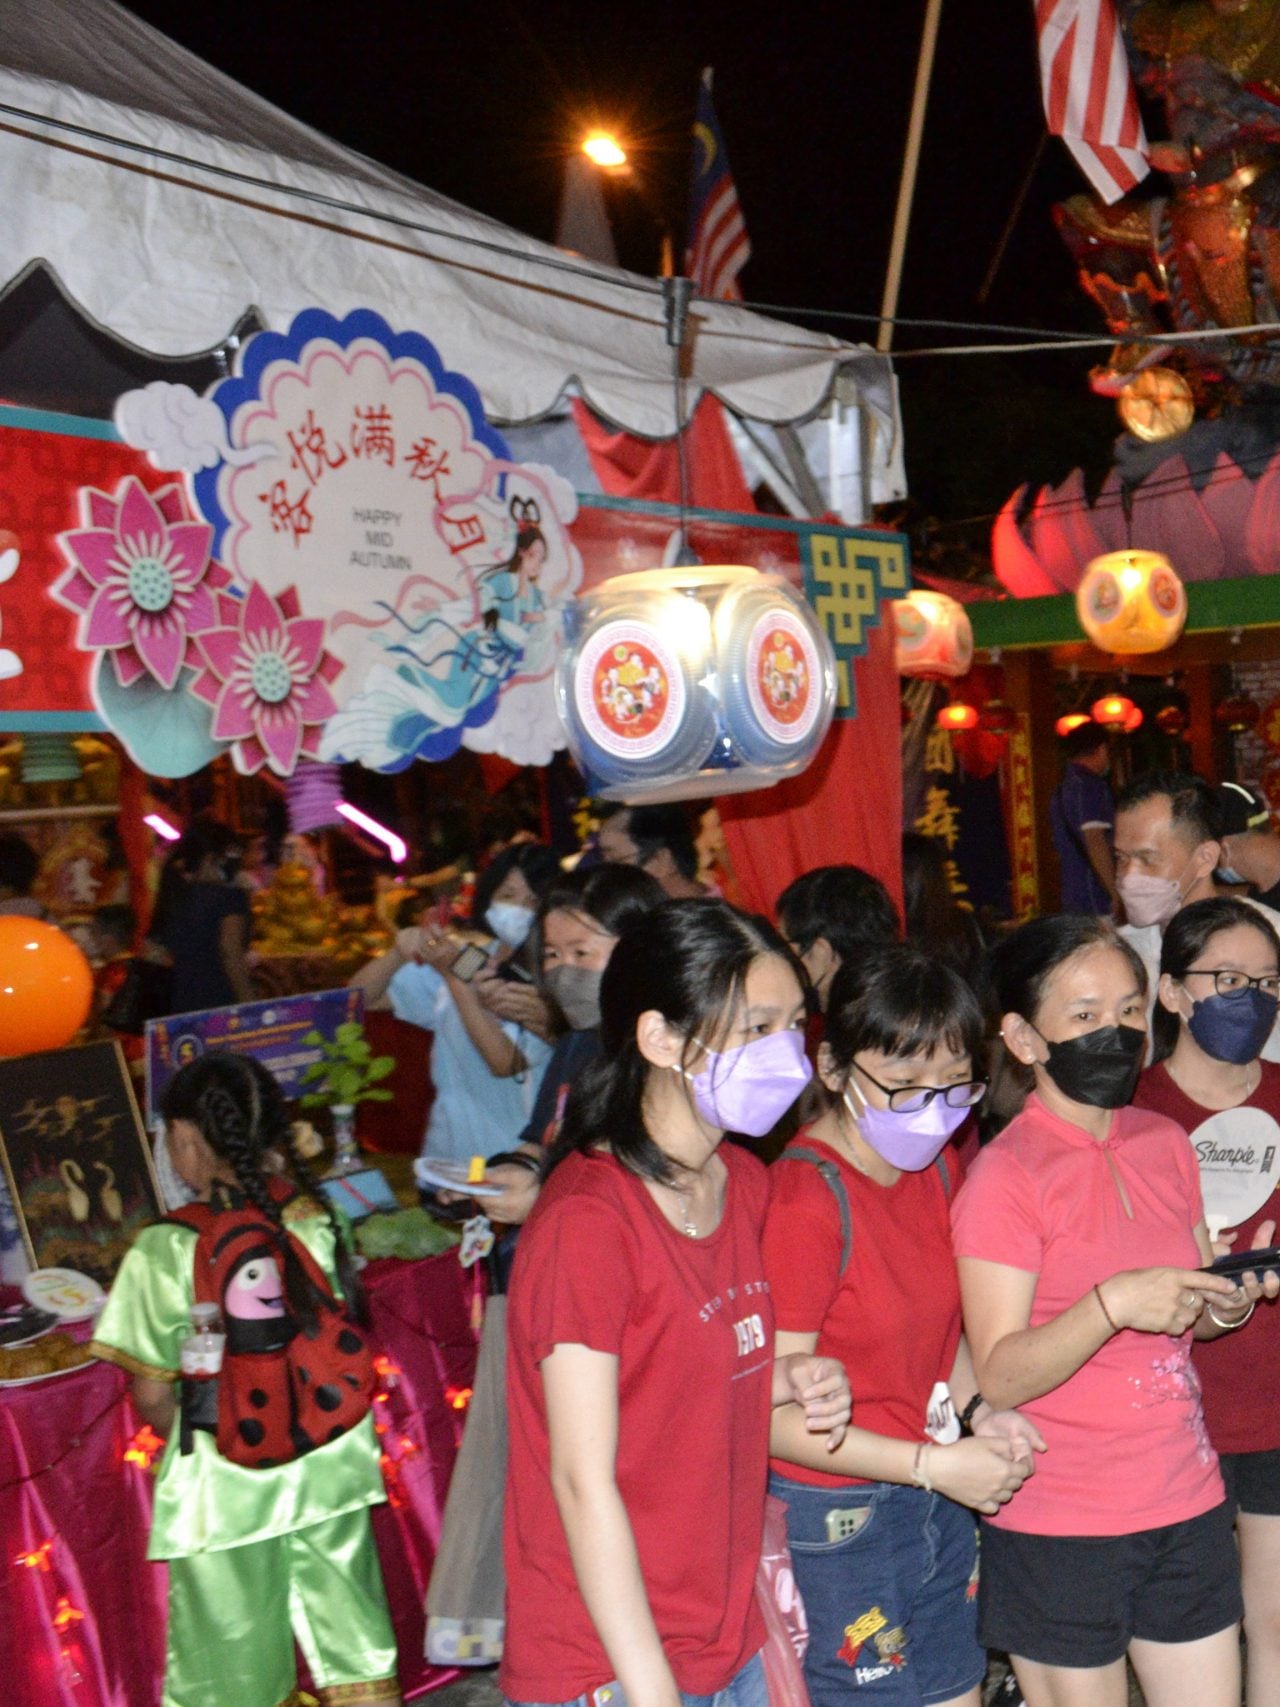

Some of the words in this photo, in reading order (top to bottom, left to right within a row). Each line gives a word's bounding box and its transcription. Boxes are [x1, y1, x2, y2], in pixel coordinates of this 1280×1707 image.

[352, 507, 402, 526] HAPPY
[365, 531, 394, 547] MID
[350, 551, 413, 571] AUTUMN
[1195, 1140, 1255, 1168] Sharpie
